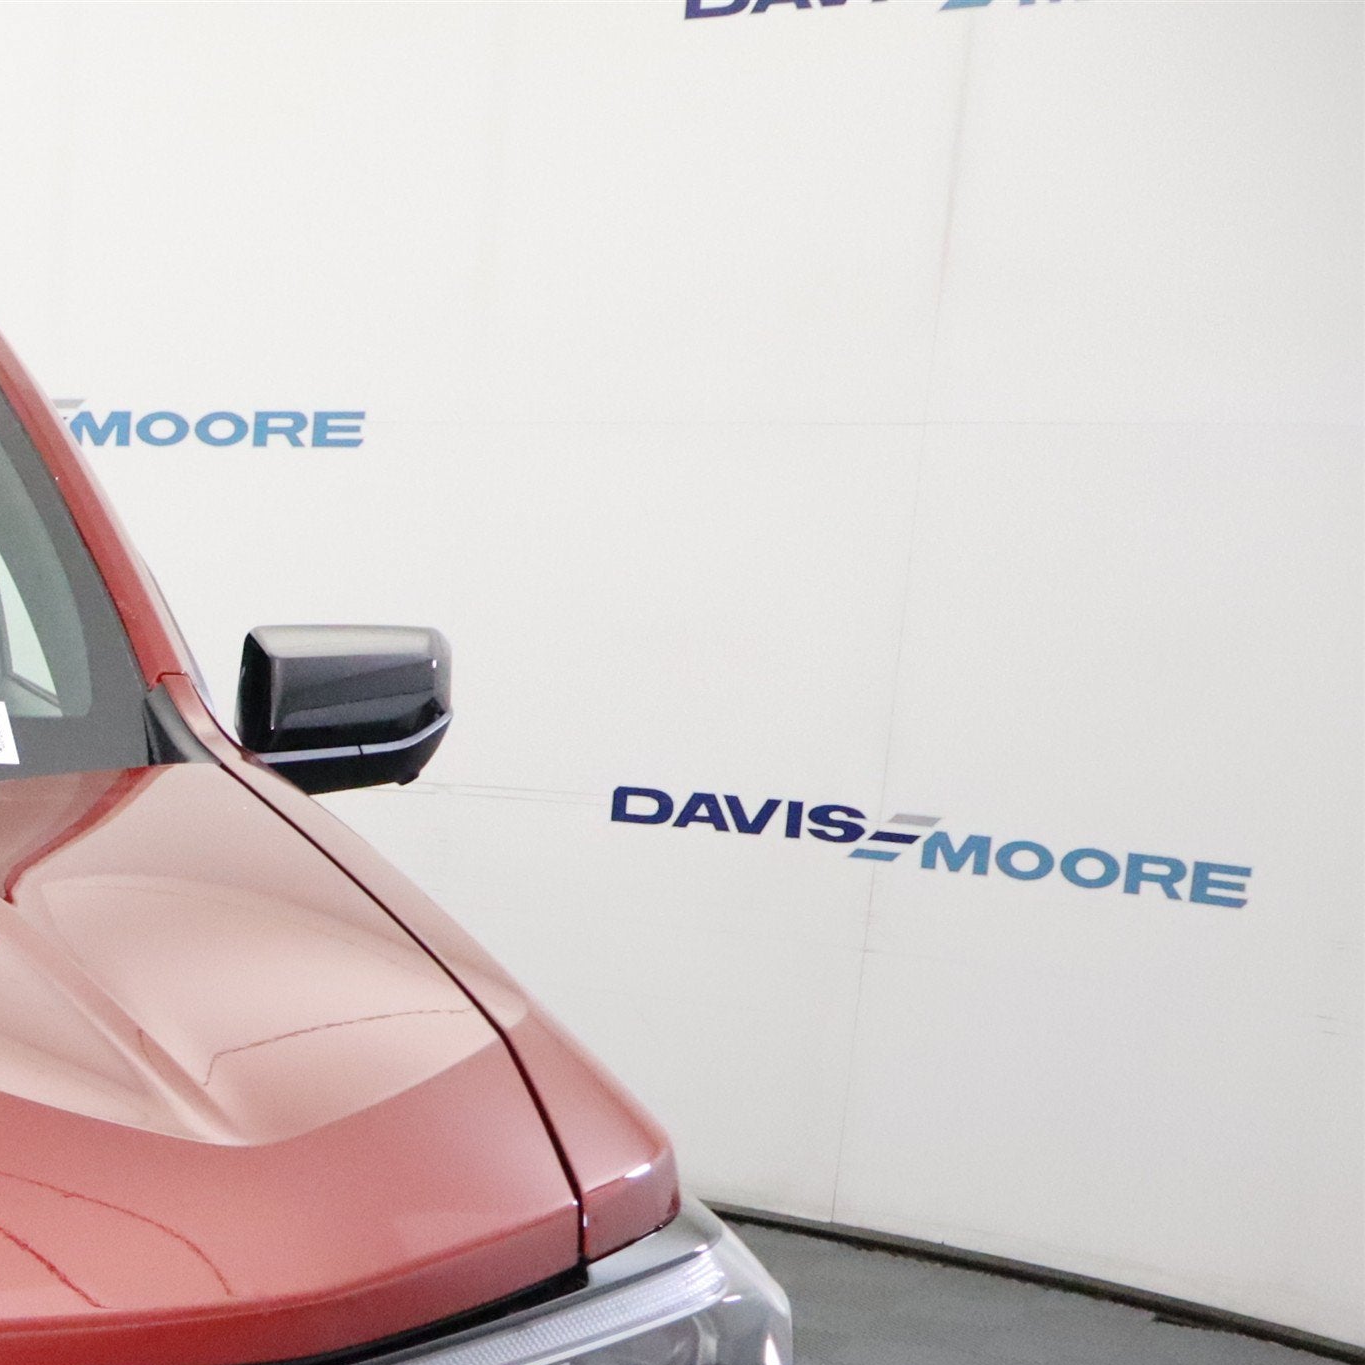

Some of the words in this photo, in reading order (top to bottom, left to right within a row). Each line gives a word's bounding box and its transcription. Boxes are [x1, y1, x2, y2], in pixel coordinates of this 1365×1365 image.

[69, 410, 367, 449] MOORE
[609, 785, 868, 845] DAVIS
[919, 829, 1254, 909] MOORE
